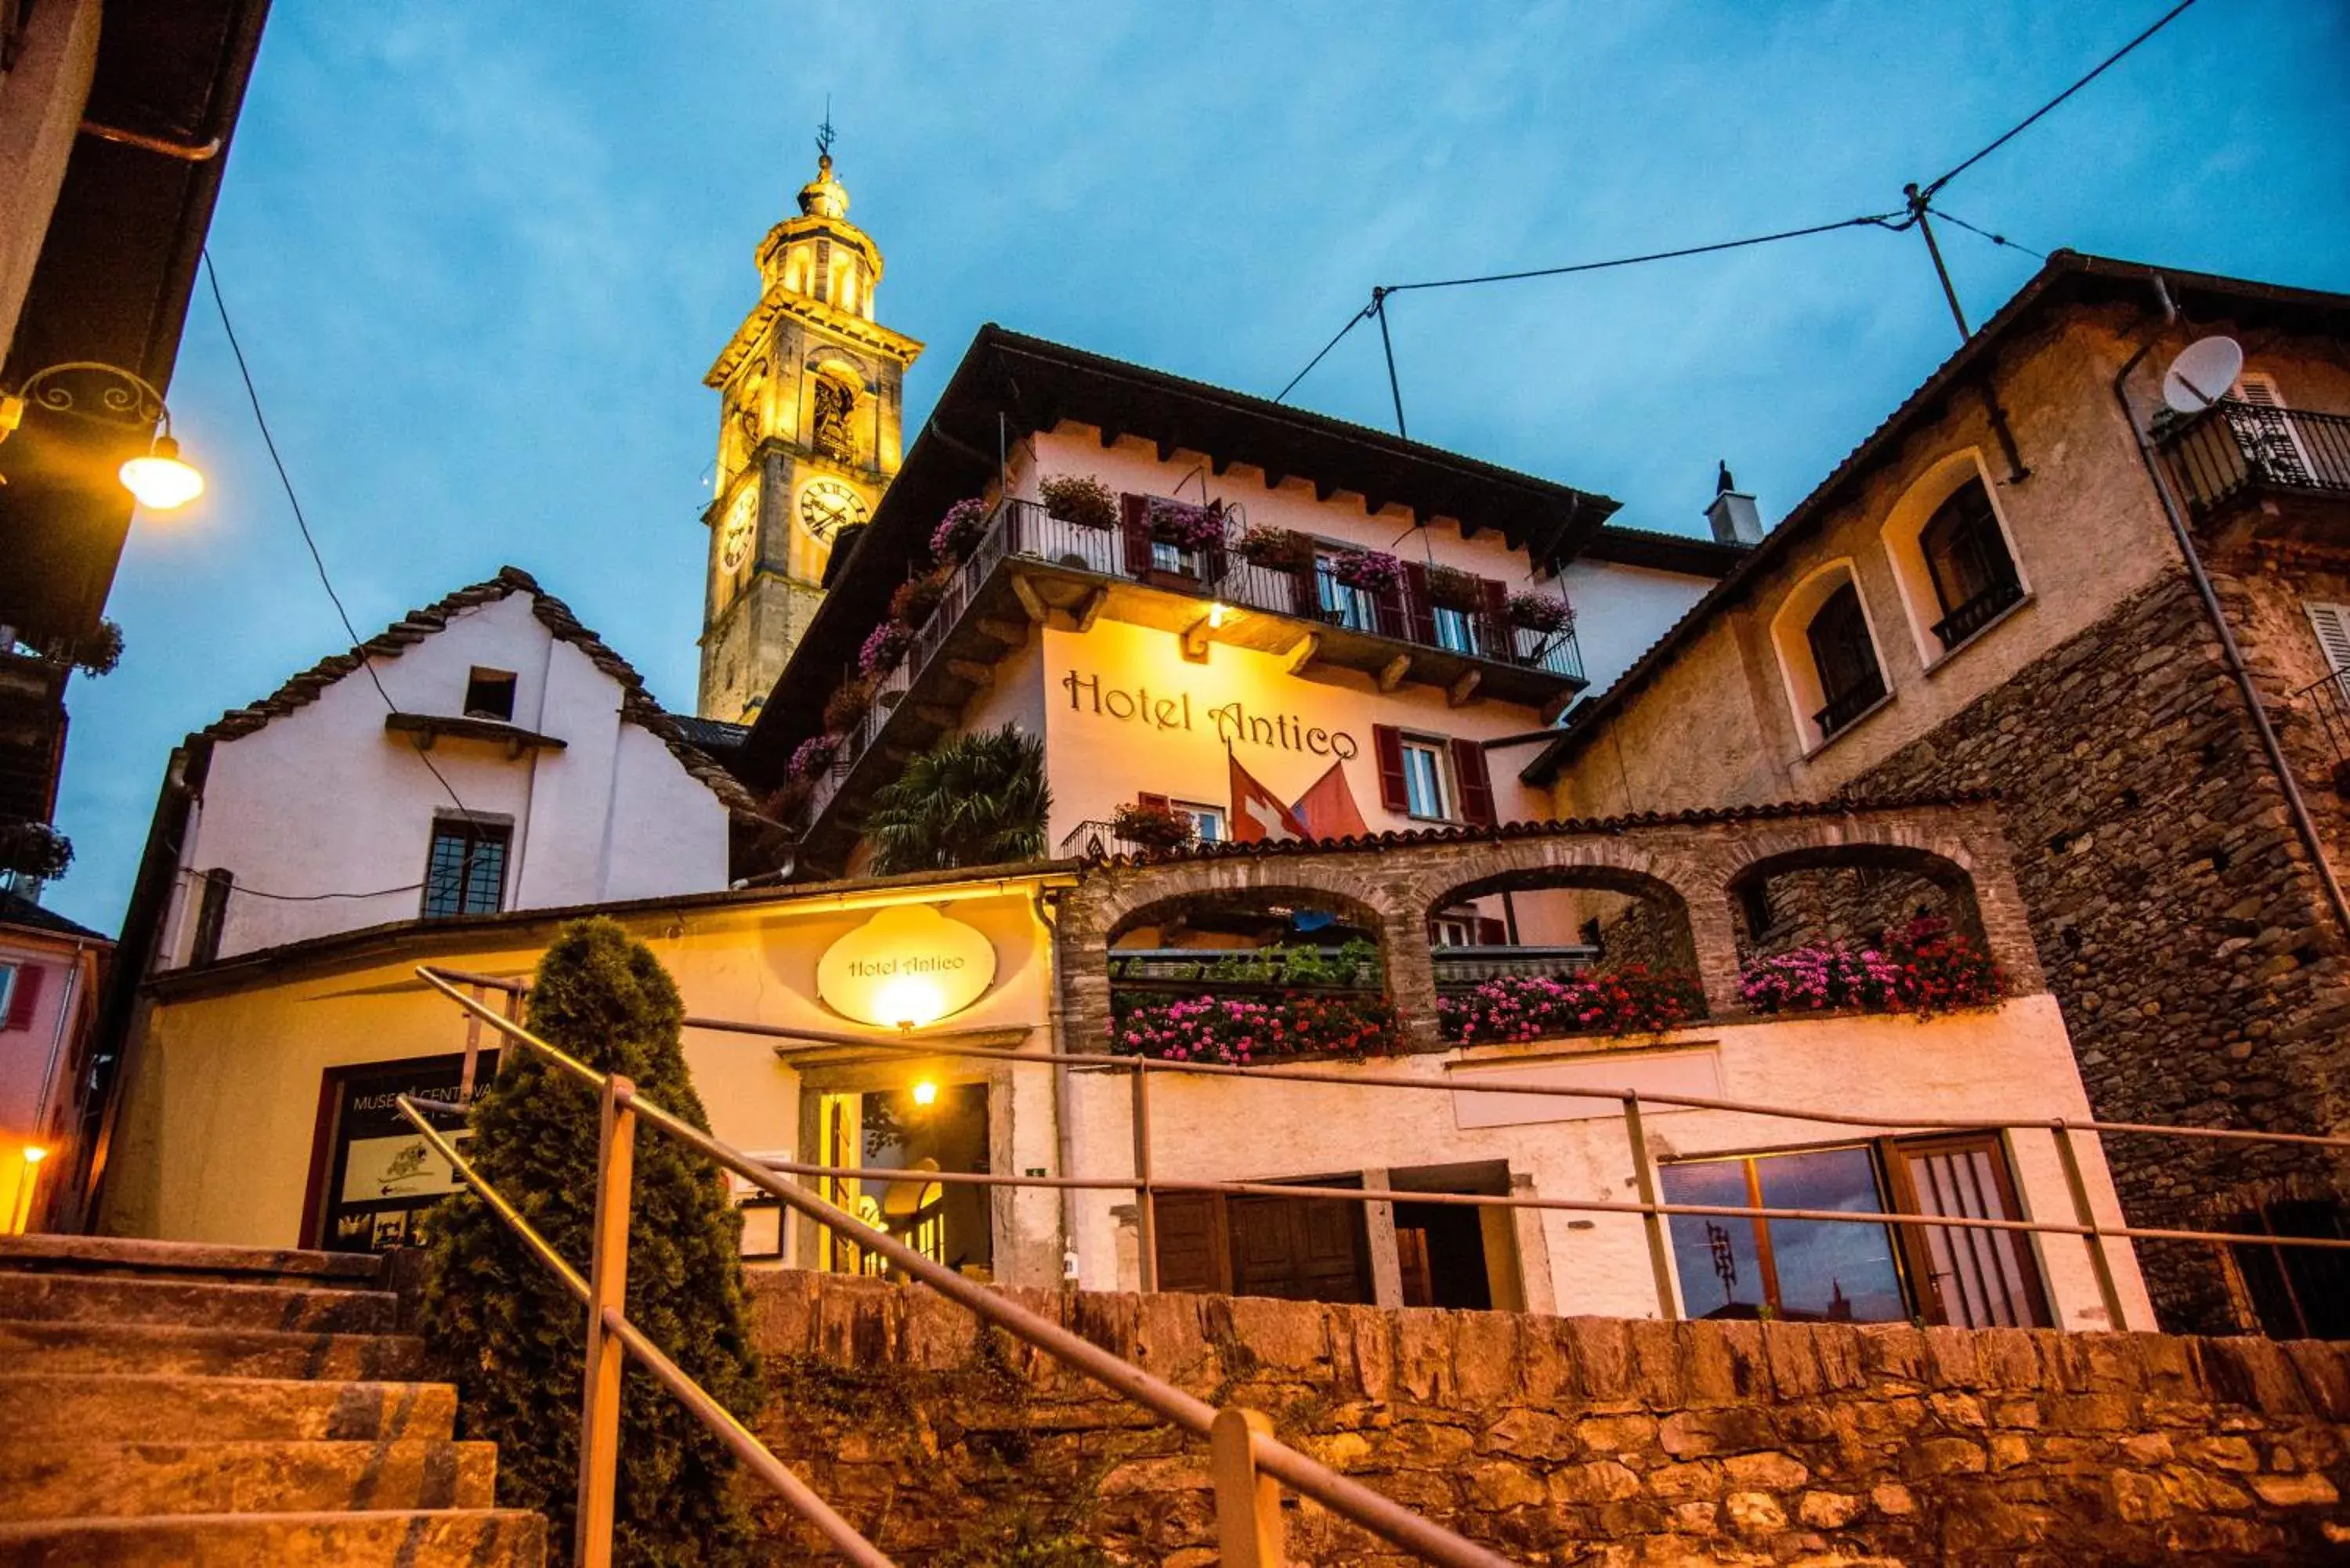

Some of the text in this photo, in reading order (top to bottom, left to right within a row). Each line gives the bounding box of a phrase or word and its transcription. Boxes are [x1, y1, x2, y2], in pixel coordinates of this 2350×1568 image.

[1062, 670, 1358, 759] Hotel Antico
[848, 956, 965, 977] Hotel Antico
[353, 1093, 400, 1111] MUSE
